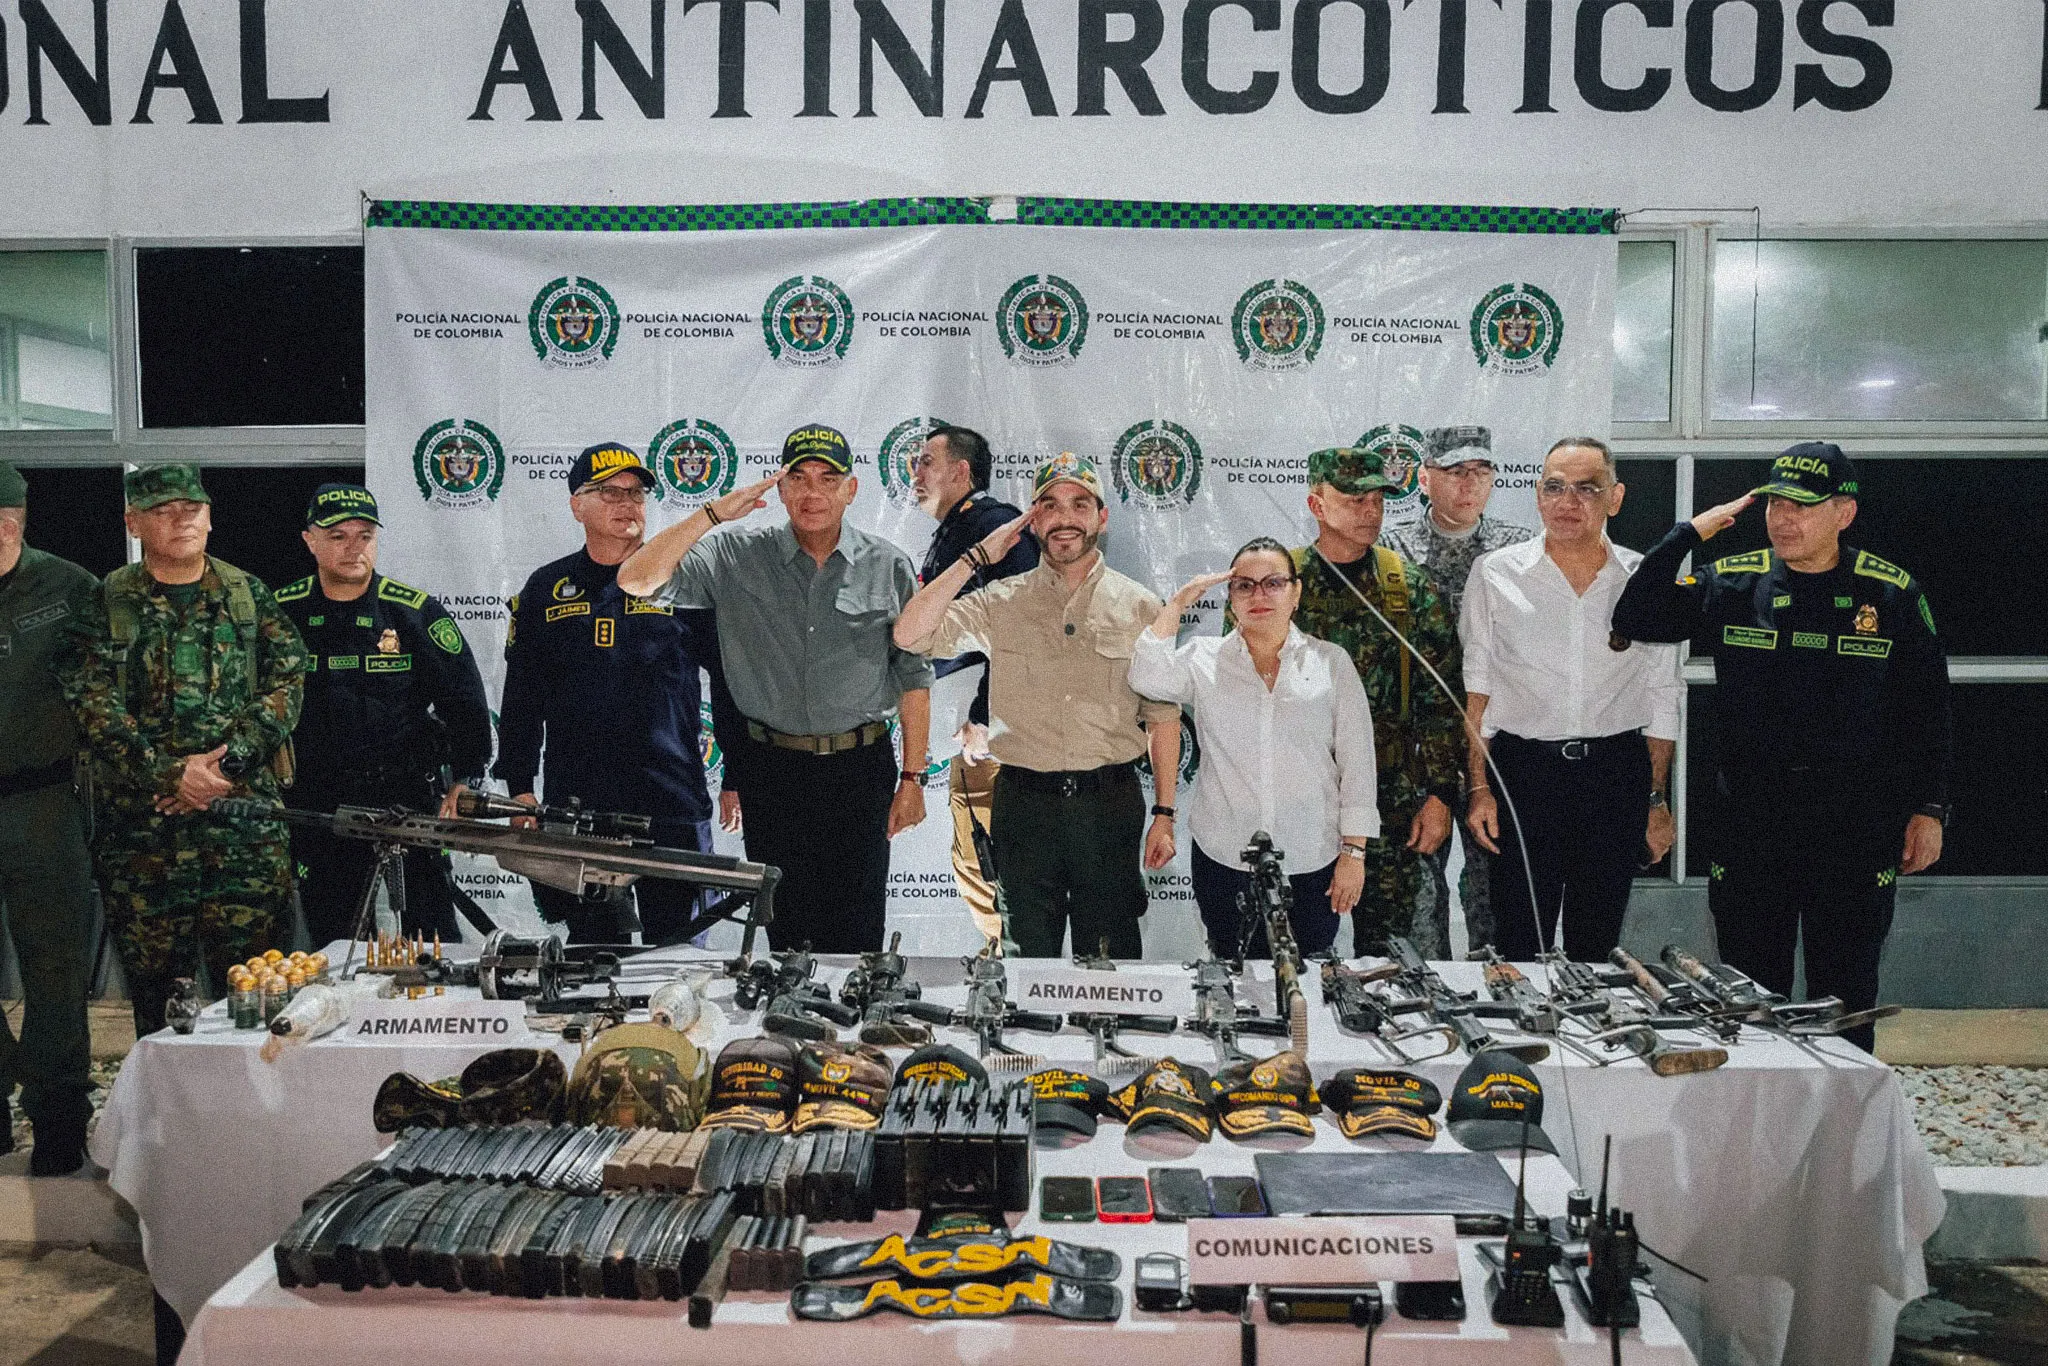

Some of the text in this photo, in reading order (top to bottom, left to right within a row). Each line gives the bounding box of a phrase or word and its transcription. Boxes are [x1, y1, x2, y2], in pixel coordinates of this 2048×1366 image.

[0, 0, 330, 126] NAL
[395, 313, 521, 325] POLICÍA NACIONAL
[626, 313, 752, 324] POLICÍA NACIONAL
[862, 311, 989, 322] POLICÍA NACIONAL
[1096, 312, 1223, 325] POLICÍA NACIONAL
[1333, 317, 1461, 330] POLICÍA NACIONAL
[413, 328, 503, 339] DE COLOMBIA
[643, 327, 734, 338] DE COLOMBIA
[879, 326, 971, 337] DE COLOMBIA
[1113, 328, 1205, 340] DE COLOMBIA
[1350, 332, 1443, 344] DE COLOMBIA
[512, 453, 564, 465] POLICÍA
[745, 455, 783, 465] POLIC
[1211, 455, 1309, 469] POLICÍA NACIO
[1504, 463, 1542, 474] NACIO
[529, 470, 546, 480] DE
[996, 470, 1013, 479] DE
[1228, 473, 1310, 484] DE COLOMBI
[1494, 478, 1533, 489] OLOM
[450, 610, 505, 621] OLOMBIA
[454, 874, 523, 885] NACIONAL
[1148, 875, 1191, 886] NACIO
[465, 889, 505, 900] OMBIA
[1029, 983, 1163, 1003] ARMAMENTO
[358, 1017, 509, 1035] ARMAMENTO
[1195, 1236, 1434, 1257] COMUNICACIONES
